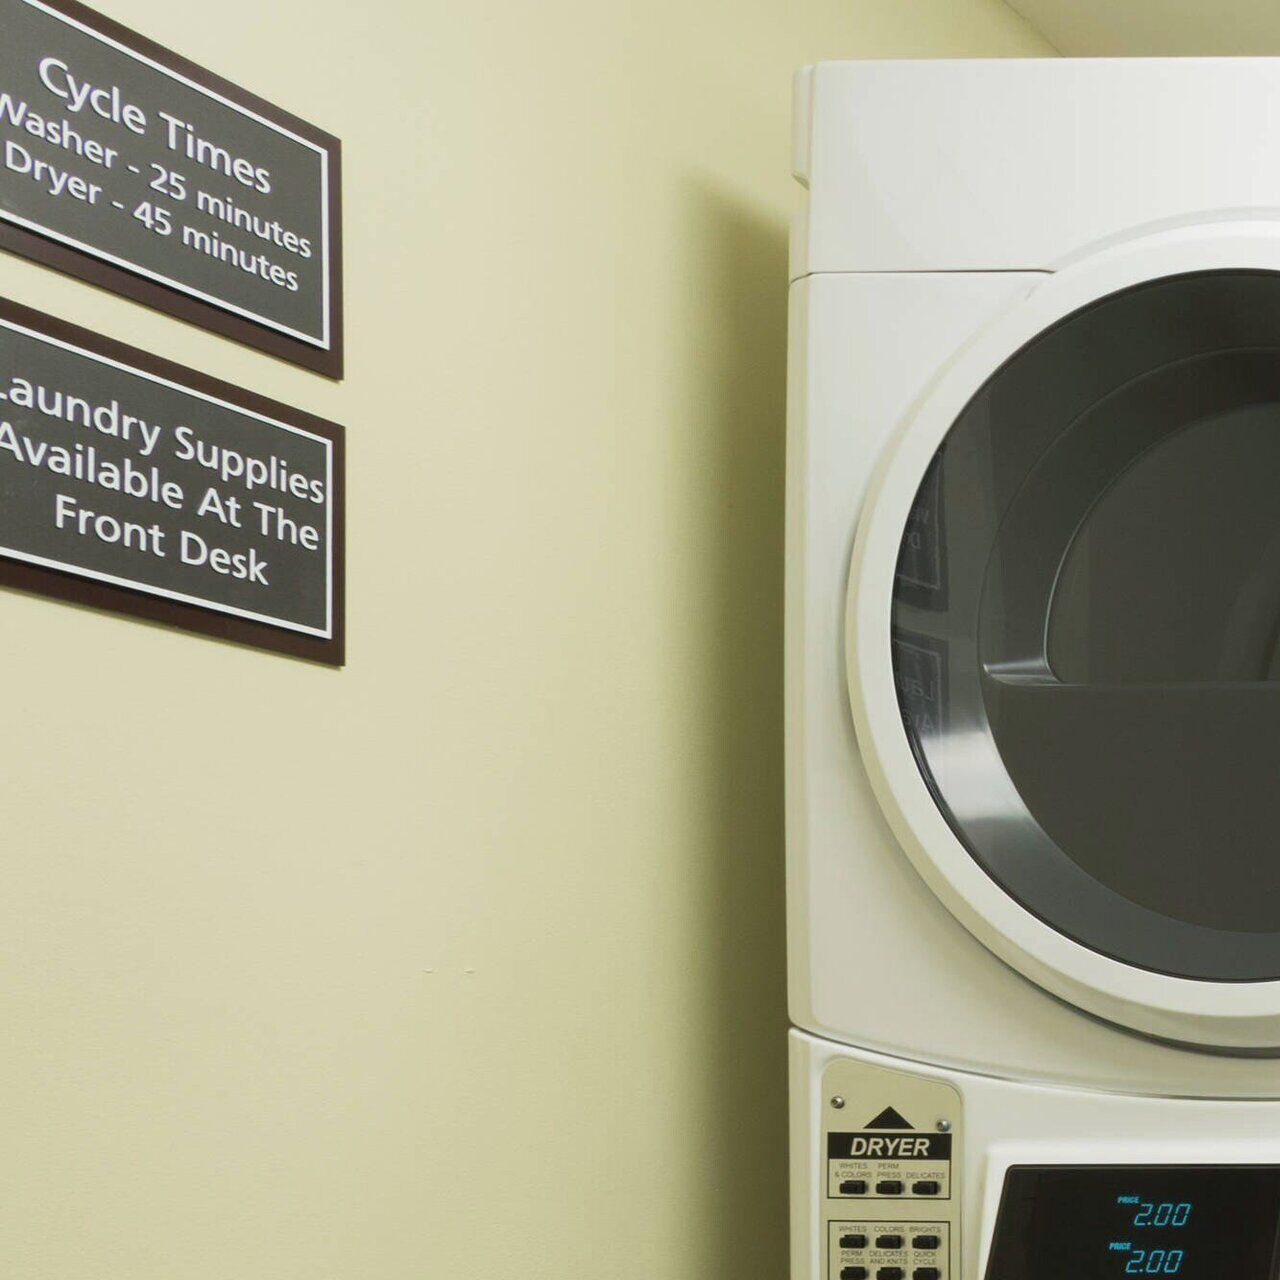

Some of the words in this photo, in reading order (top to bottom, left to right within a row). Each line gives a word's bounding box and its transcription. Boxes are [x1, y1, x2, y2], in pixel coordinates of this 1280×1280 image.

[39, 57, 146, 134] Cycle
[159, 111, 272, 194] Times
[5, 140, 102, 205] Dryer
[133, 202, 172, 236] 45
[182, 225, 299, 291] minutes
[128, 165, 140, 174] -
[150, 163, 187, 200] 25
[197, 190, 312, 258] minutes
[0, 377, 160, 456] aundry
[174, 426, 325, 504] Supplies
[0, 421, 184, 509] Available
[197, 487, 242, 528] At
[253, 501, 319, 550] The
[55, 494, 166, 557] Front
[180, 531, 270, 586] Desk
[850, 1137, 930, 1157] DRYER
[839, 1162, 868, 1170] WHITES
[841, 1171, 872, 1179] COLORS
[878, 1162, 899, 1170] PERM
[906, 1172, 945, 1180] DELICATES
[1133, 1203, 1191, 1226] 2.00
[909, 1226, 941, 1234] BRIGHTS
[840, 1257, 865, 1265] PRESS
[870, 1257, 886, 1265] AND
[1125, 1250, 1183, 1273] 2.00
